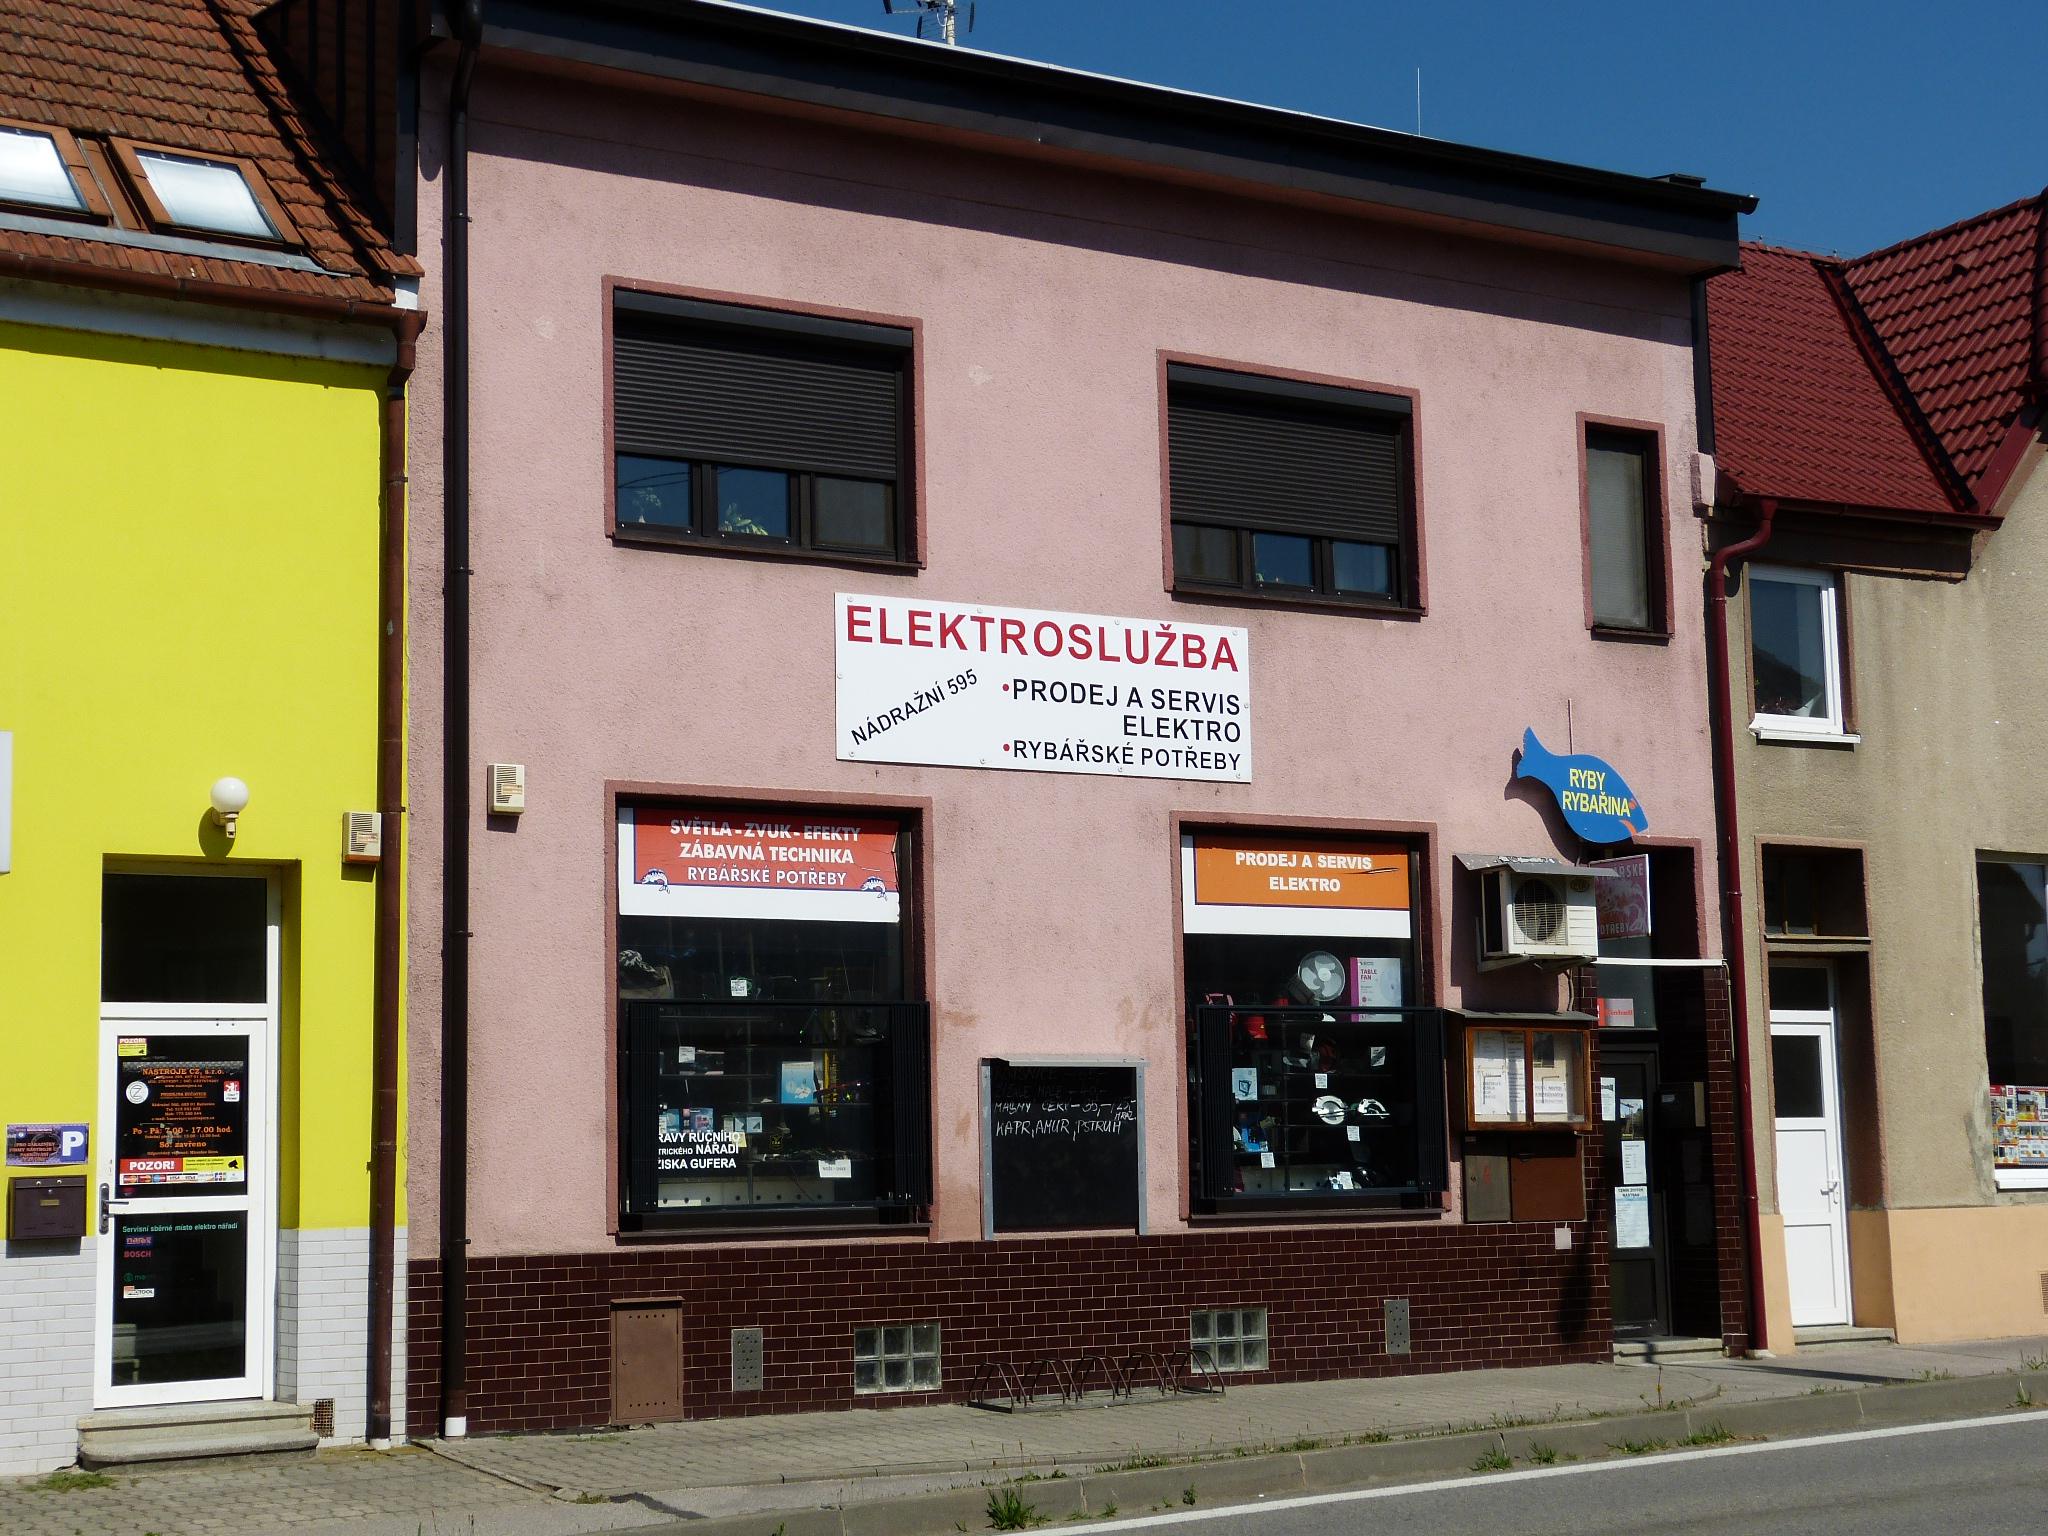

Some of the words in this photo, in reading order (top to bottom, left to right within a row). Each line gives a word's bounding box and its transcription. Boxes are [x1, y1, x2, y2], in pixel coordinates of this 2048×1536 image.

[846, 604, 1239, 672] ELEKTROSLUŽBA
[850, 681, 946, 746] NÁDRAŽNÍ
[946, 668, 978, 696] 595
[1012, 678, 1119, 707] PRODEJ
[1126, 686, 1144, 709] A
[1151, 688, 1241, 716] SERVIS
[1123, 714, 1241, 743] ELEKTRO
[1013, 737, 1134, 766] RYBÁŘSKÉ
[1140, 745, 1241, 771] POTŘEBY
[1569, 767, 1606, 791] RYBY
[1562, 790, 1632, 818] RYBAŘINA
[669, 815, 733, 837] SVĚTLA
[744, 821, 792, 841] ZVUK
[803, 824, 862, 842] EFEKTY
[679, 838, 765, 861] ZÁBAVNÁ
[768, 845, 855, 865] TECHNIKA
[1235, 851, 1297, 868] PRODEJ
[1301, 854, 1313, 869] A
[1317, 854, 1373, 871] SERVIS
[686, 862, 771, 884] RYBÁŘSKÉ
[776, 865, 848, 886] POTŘEBY
[1269, 876, 1341, 893] ELEKTRO
[216, 1126, 233, 1134] hod.
[688, 1129, 741, 1143] RUČNÍHO
[1077, 1119, 1122, 1135] PSTRUH
[62, 1130, 84, 1156] P
[695, 1141, 740, 1155] NÁŘADÍ
[129, 1160, 176, 1171] POZOR!
[690, 1157, 737, 1169] GUFERA
[122, 1225, 149, 1233] Servisní
[218, 1221, 238, 1230] nářadí
[124, 1250, 152, 1258] BOSCH
